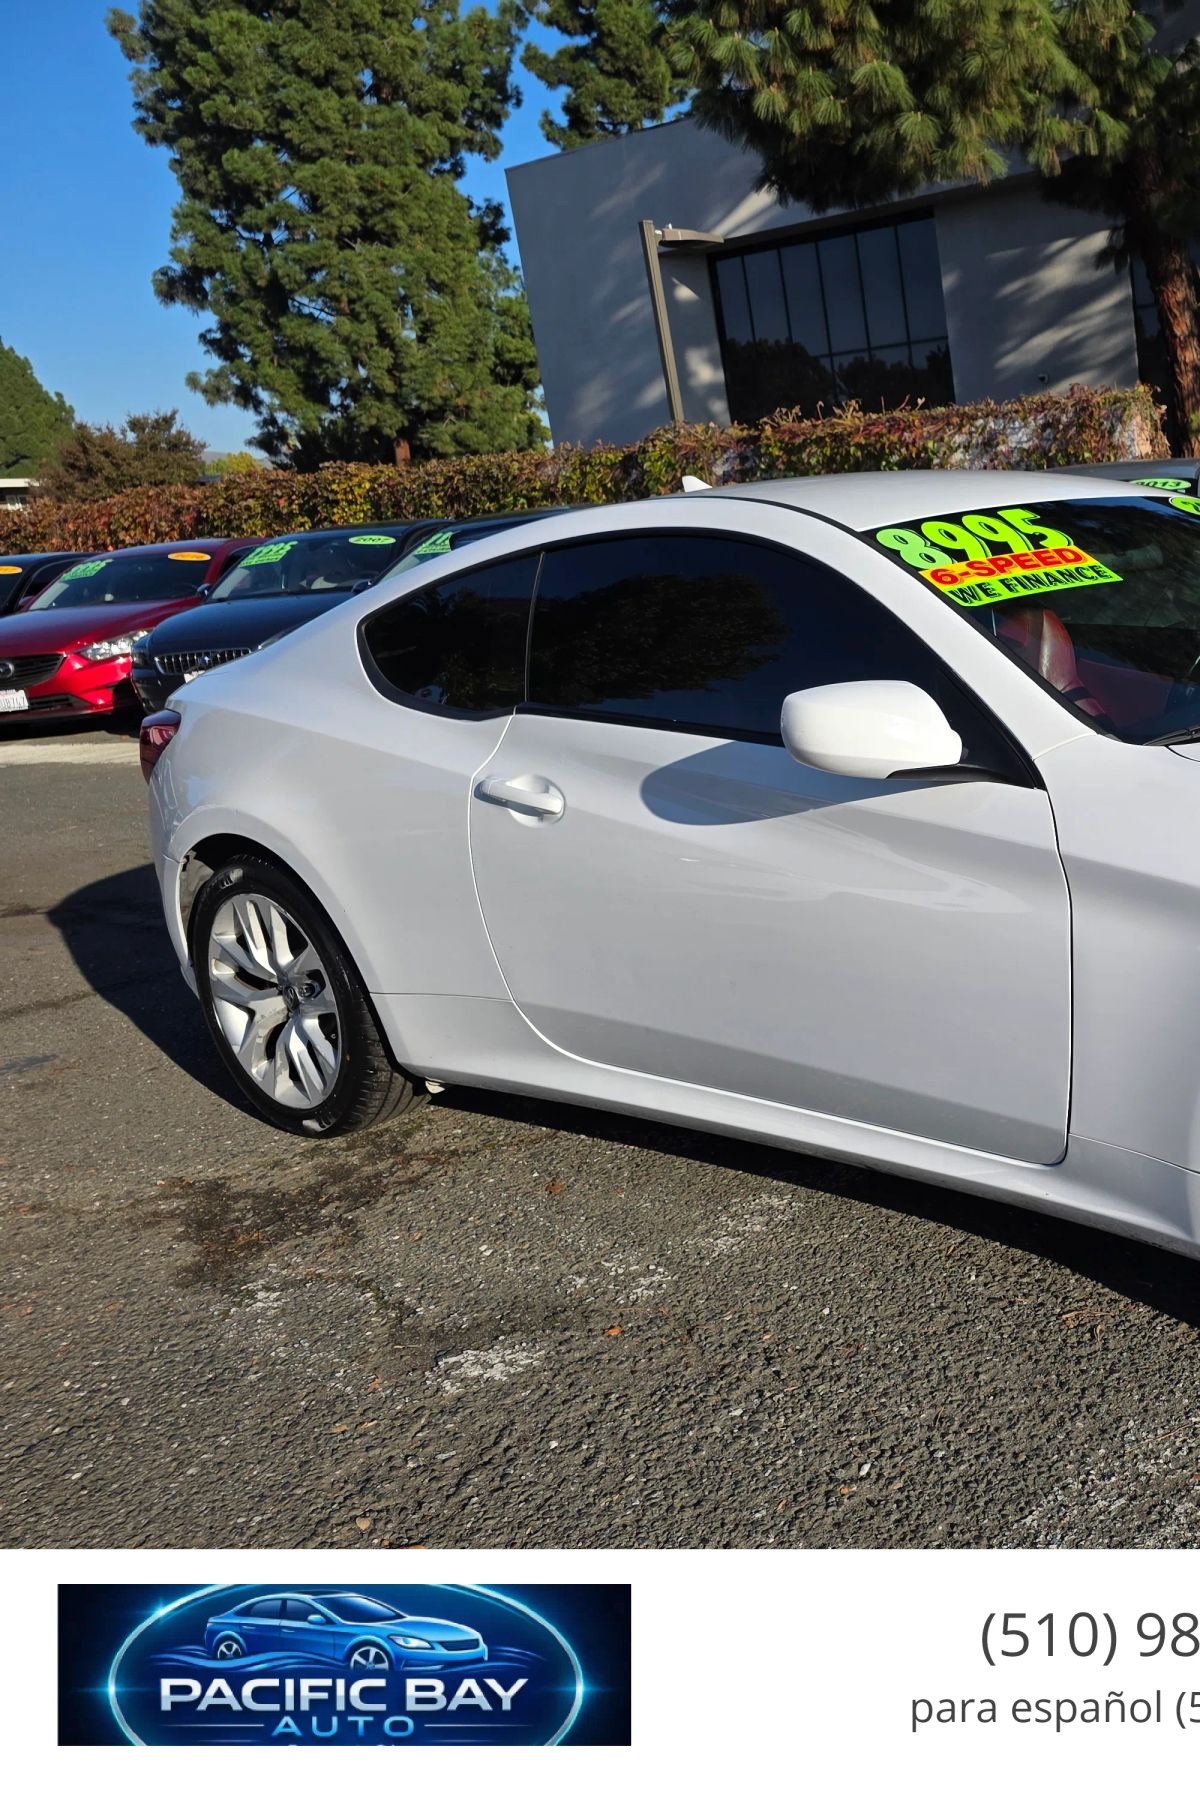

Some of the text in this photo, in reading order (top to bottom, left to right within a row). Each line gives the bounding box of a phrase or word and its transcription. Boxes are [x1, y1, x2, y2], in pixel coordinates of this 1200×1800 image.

[876, 508, 1074, 570] 8995
[930, 547, 1088, 586] 6-SPEED
[947, 564, 1113, 604] WE FINANCE
